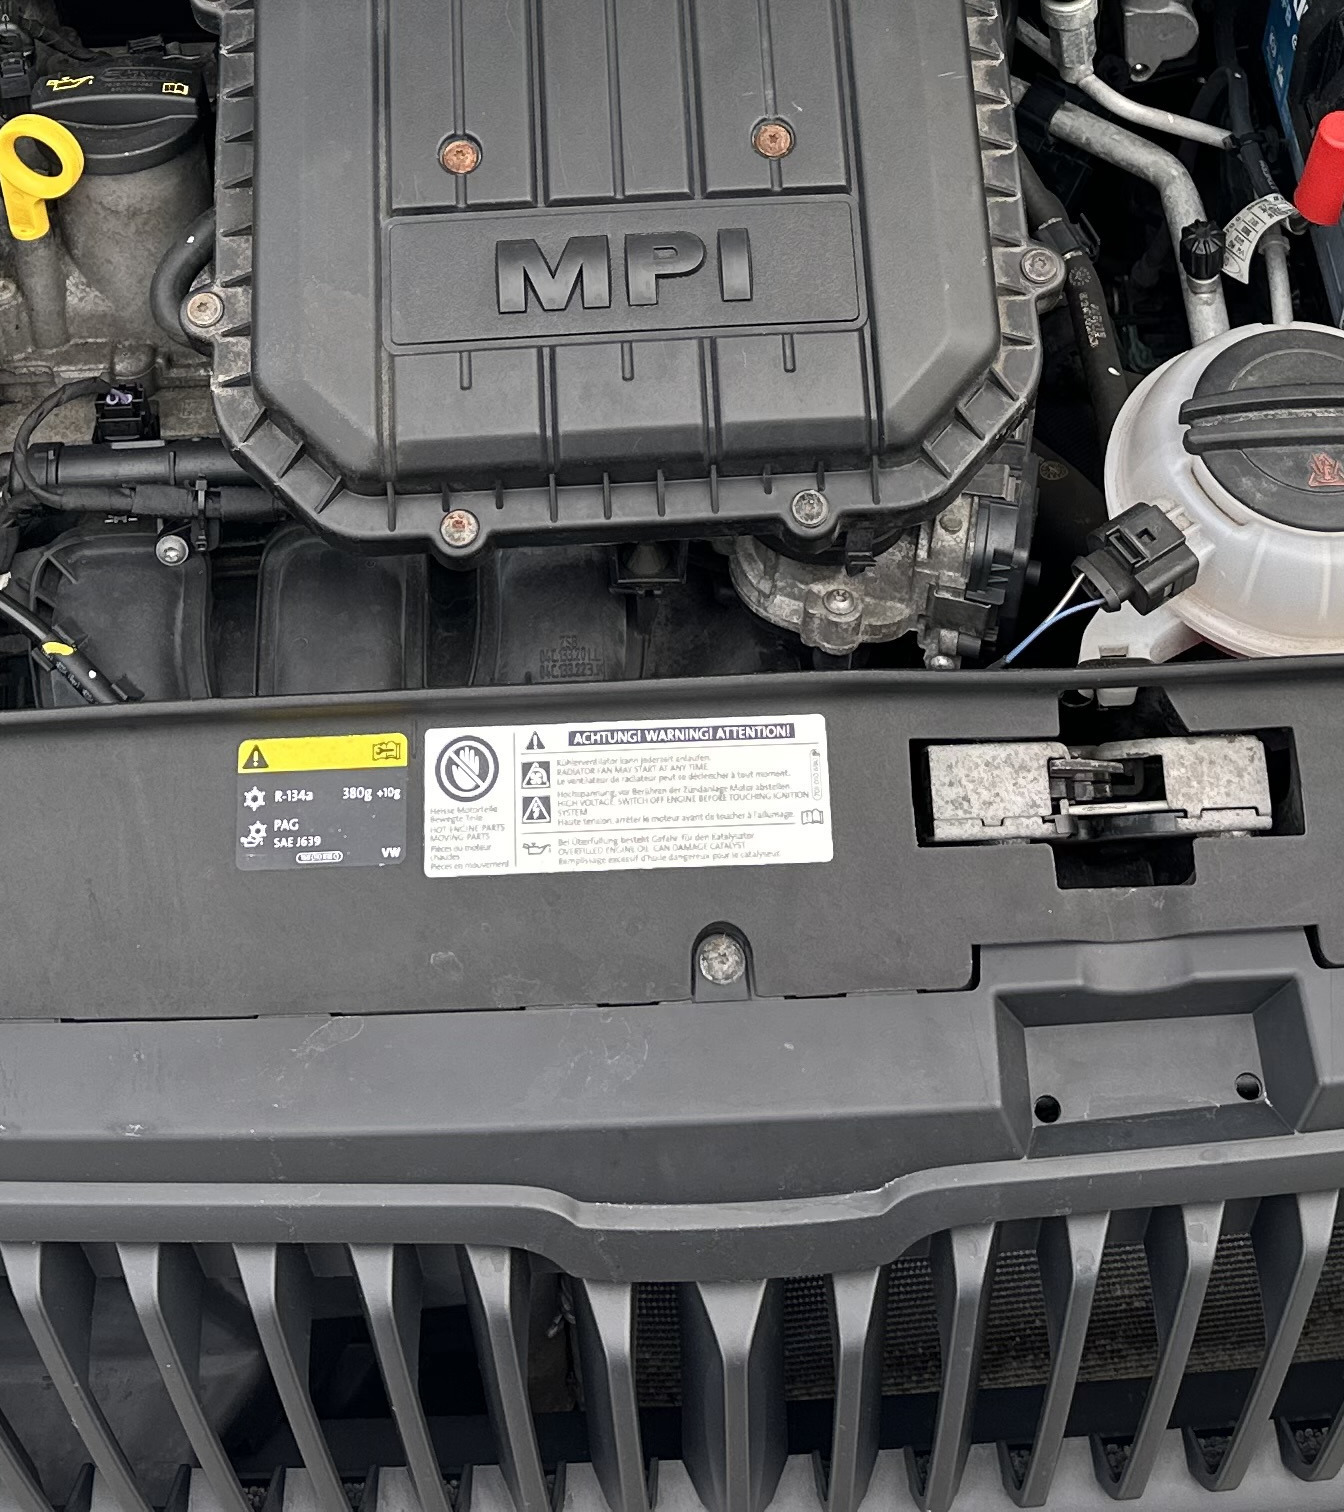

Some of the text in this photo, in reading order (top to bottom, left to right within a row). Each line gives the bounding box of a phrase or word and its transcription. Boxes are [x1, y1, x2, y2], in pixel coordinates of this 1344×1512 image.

[496, 227, 753, 314] MPI
[573, 723, 791, 745] ACHTUNG! WARNING! ATTENTION!
[273, 788, 314, 803] R-134a
[342, 786, 373, 803] 380g
[273, 818, 299, 833] PAG
[273, 835, 321, 849] SAE J639
[381, 846, 402, 859] VW
